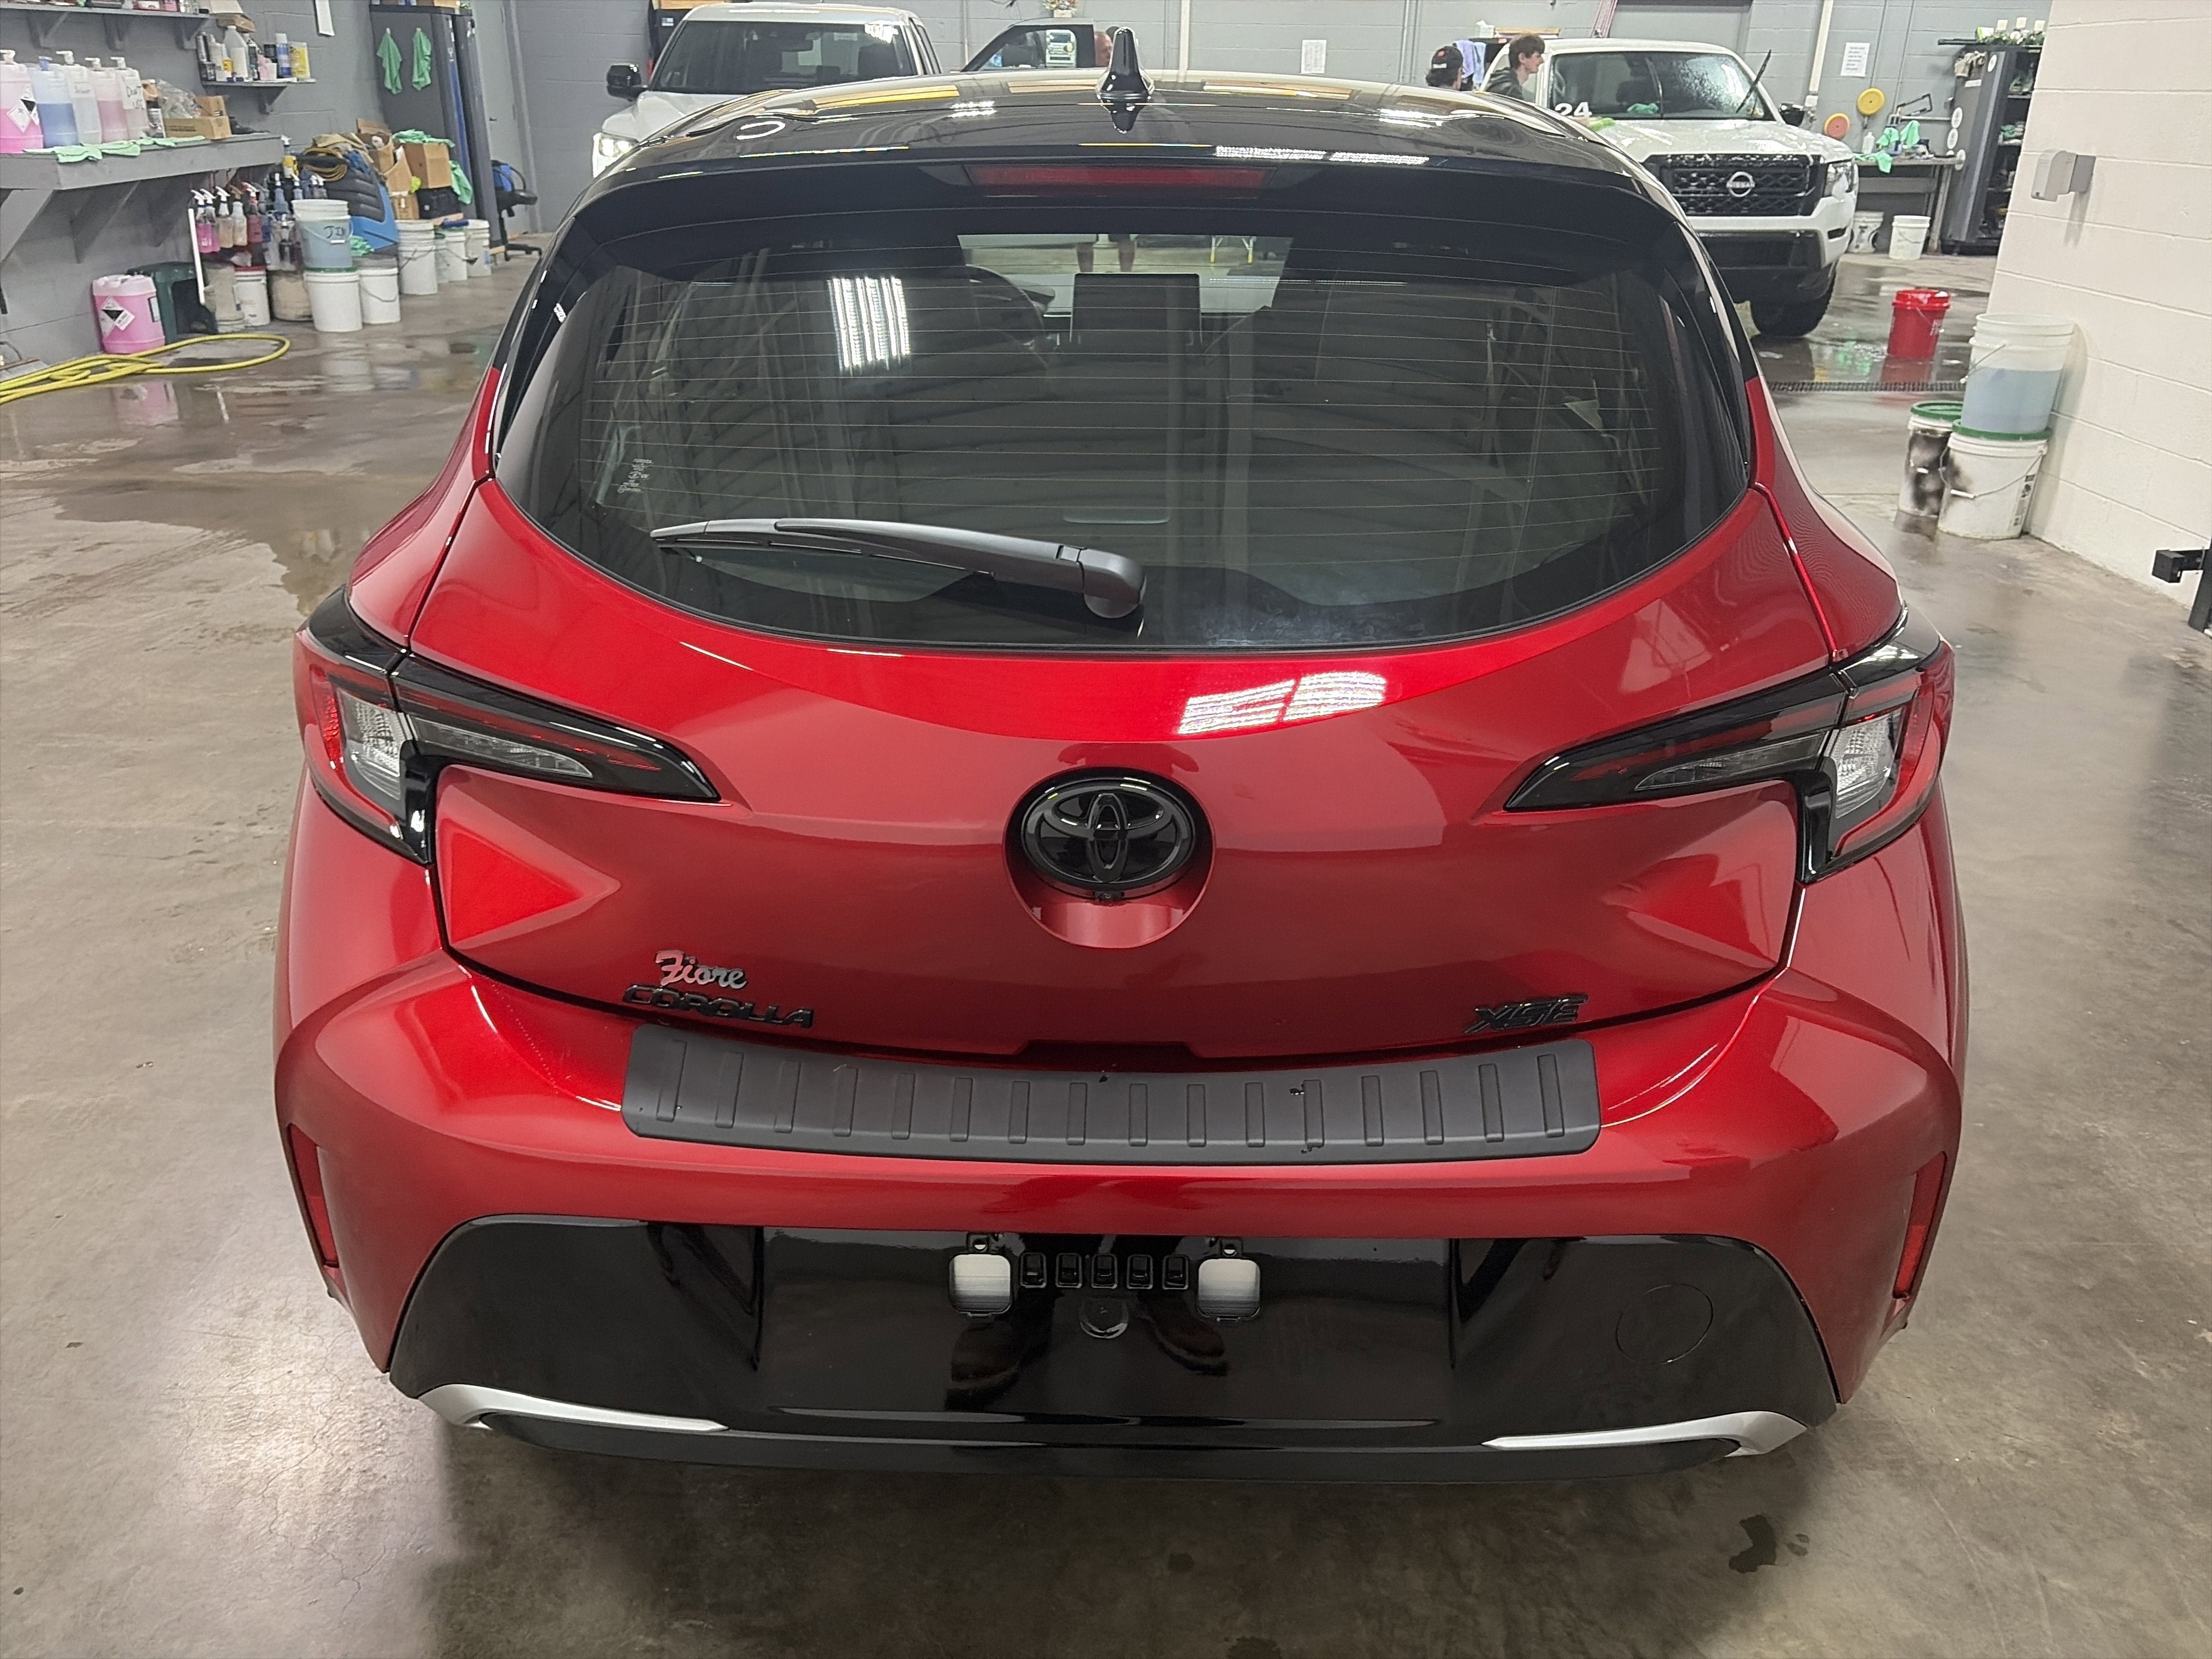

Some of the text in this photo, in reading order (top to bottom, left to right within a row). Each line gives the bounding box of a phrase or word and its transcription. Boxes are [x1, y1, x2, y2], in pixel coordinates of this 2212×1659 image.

[1555, 101, 1593, 117] 24
[655, 949, 747, 989] Fiore
[623, 985, 814, 1028] COROLLA
[1463, 992, 1589, 1035] XSE
